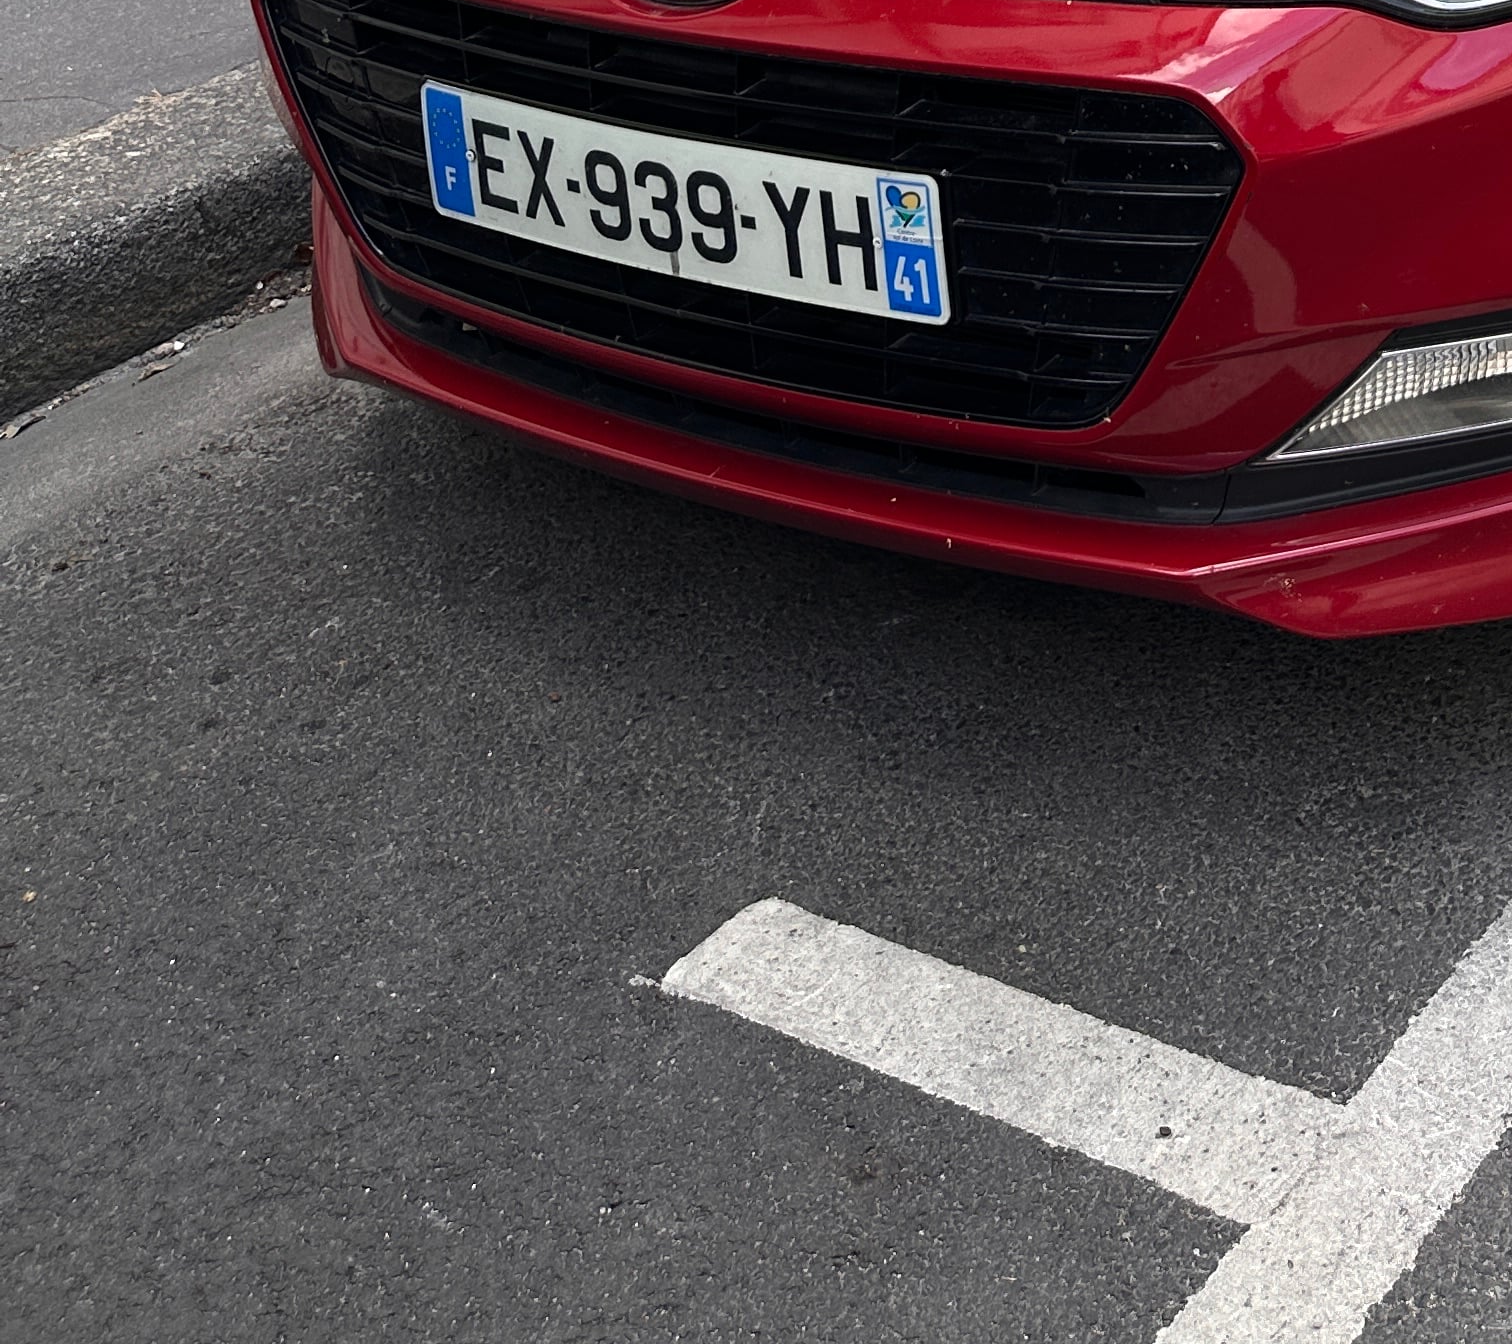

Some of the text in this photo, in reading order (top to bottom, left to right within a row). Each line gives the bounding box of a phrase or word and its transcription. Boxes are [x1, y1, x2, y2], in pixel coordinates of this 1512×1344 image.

[444, 165, 457, 191] F
[472, 118, 879, 292] EX-939-YH
[894, 255, 931, 305] 41
